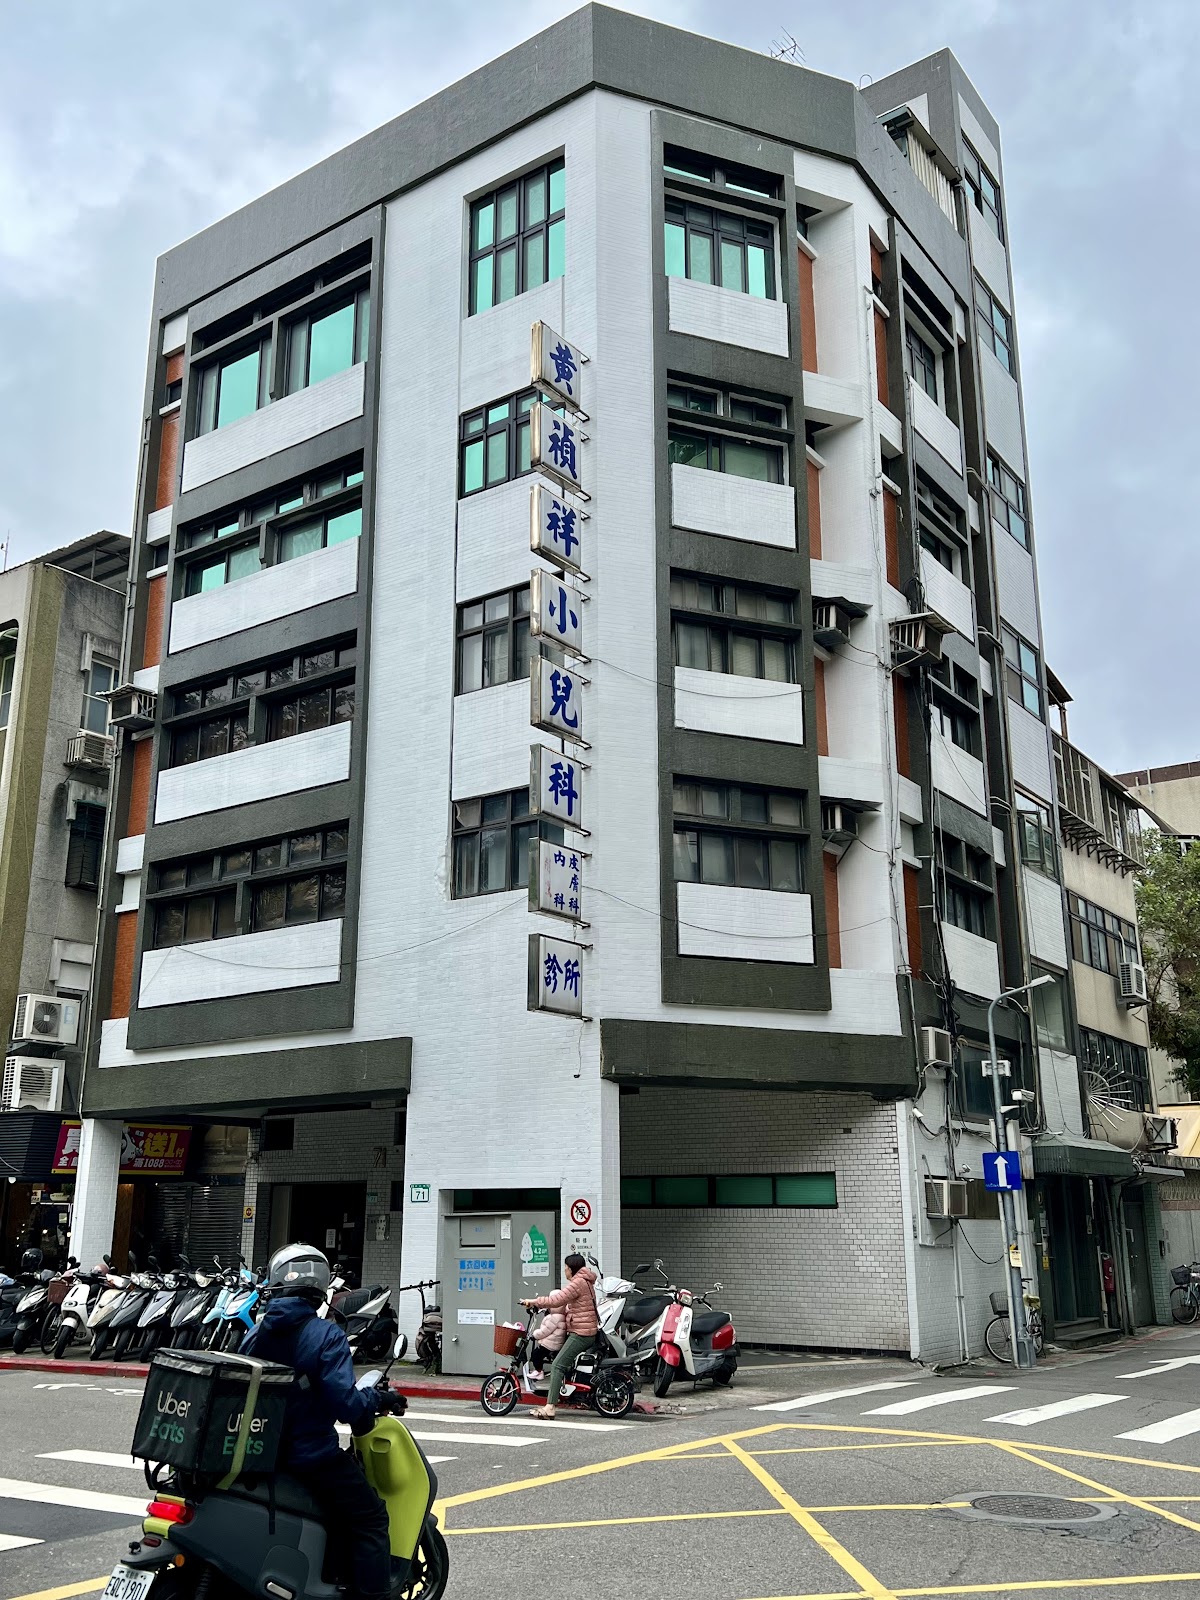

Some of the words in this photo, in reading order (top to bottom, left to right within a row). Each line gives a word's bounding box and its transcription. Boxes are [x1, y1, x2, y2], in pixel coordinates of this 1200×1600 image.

[568, 853, 580, 915] 皮膚科
[544, 952, 581, 998] 診所
[373, 1147, 387, 1168] 71
[415, 1190, 425, 1200] 71
[157, 1390, 192, 1419] Uber
[149, 1415, 185, 1444] Eats
[222, 1435, 264, 1455] Ets
